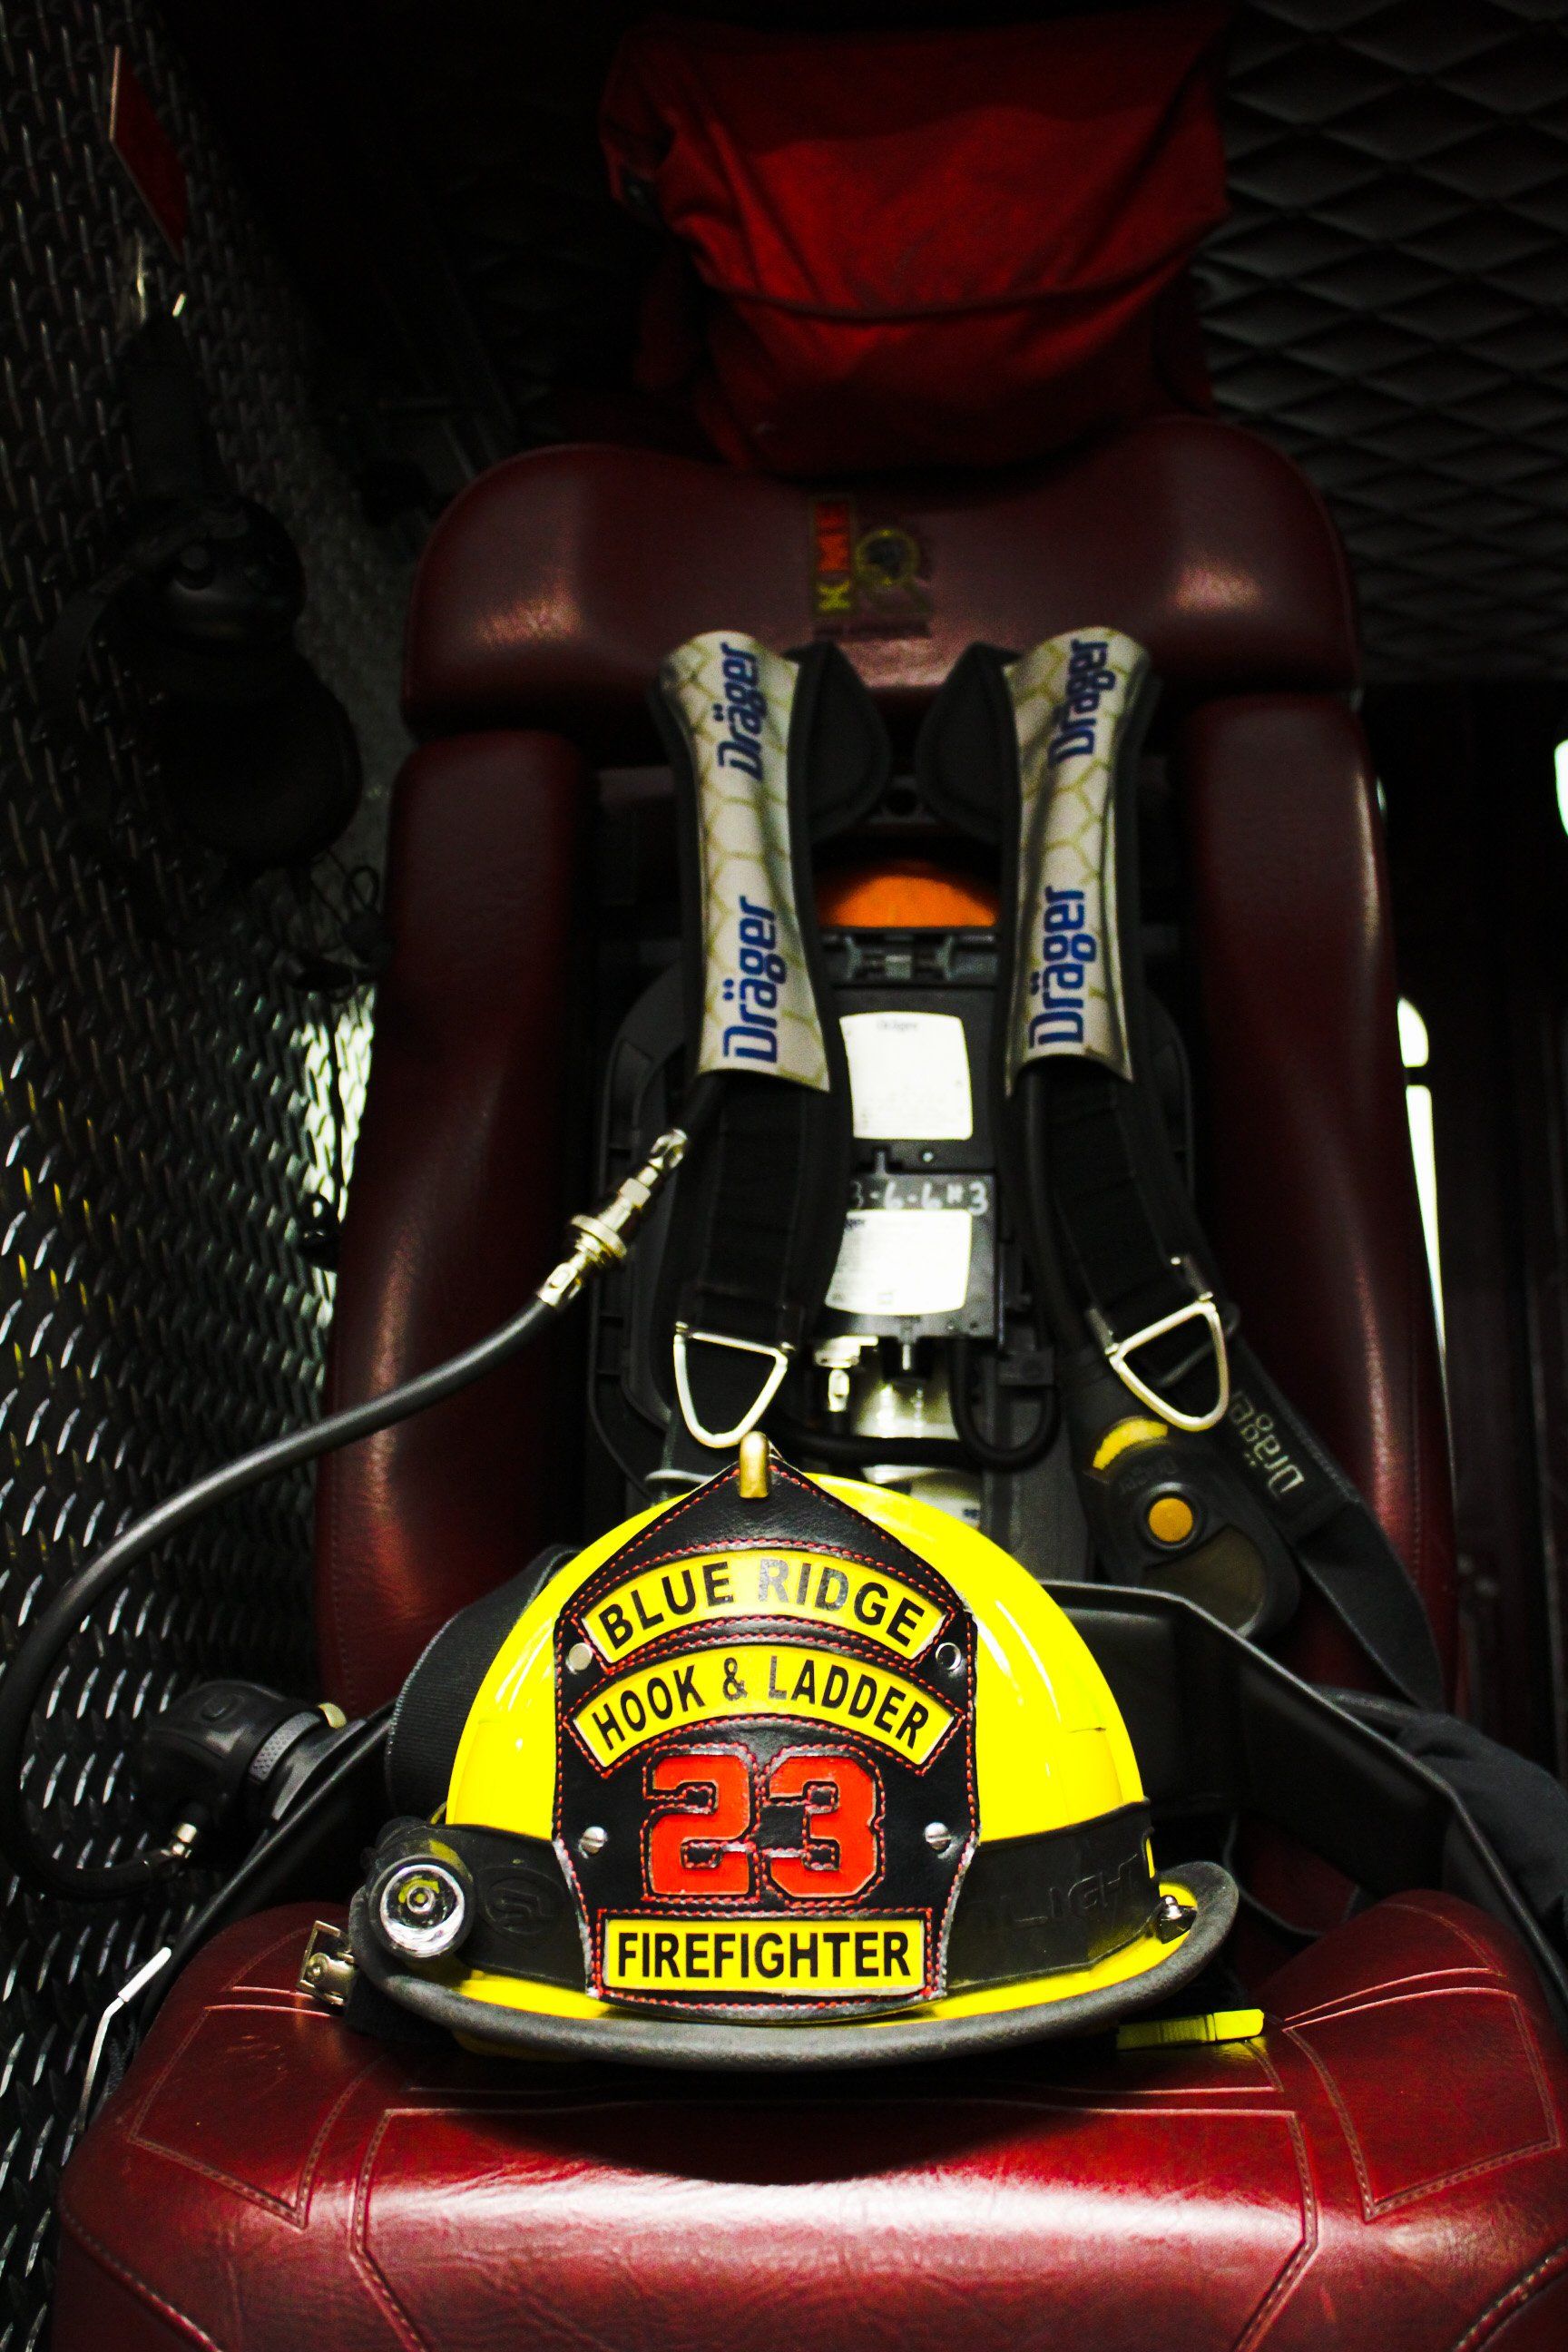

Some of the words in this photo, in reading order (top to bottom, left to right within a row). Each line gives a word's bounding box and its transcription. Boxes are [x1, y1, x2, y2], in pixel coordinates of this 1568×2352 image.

[713, 642, 767, 781] Dräger
[721, 896, 787, 1064] Dräger
[1028, 886, 1097, 1049] Dräger
[599, 1561, 734, 1651] BLUE
[757, 1558, 926, 1648] RIDGE
[591, 1663, 703, 1750] HOOK
[722, 1657, 748, 1700] &
[768, 1655, 930, 1749] LADDER
[650, 1753, 877, 1898] 23
[616, 1931, 912, 1978] FIREFIGHTER
